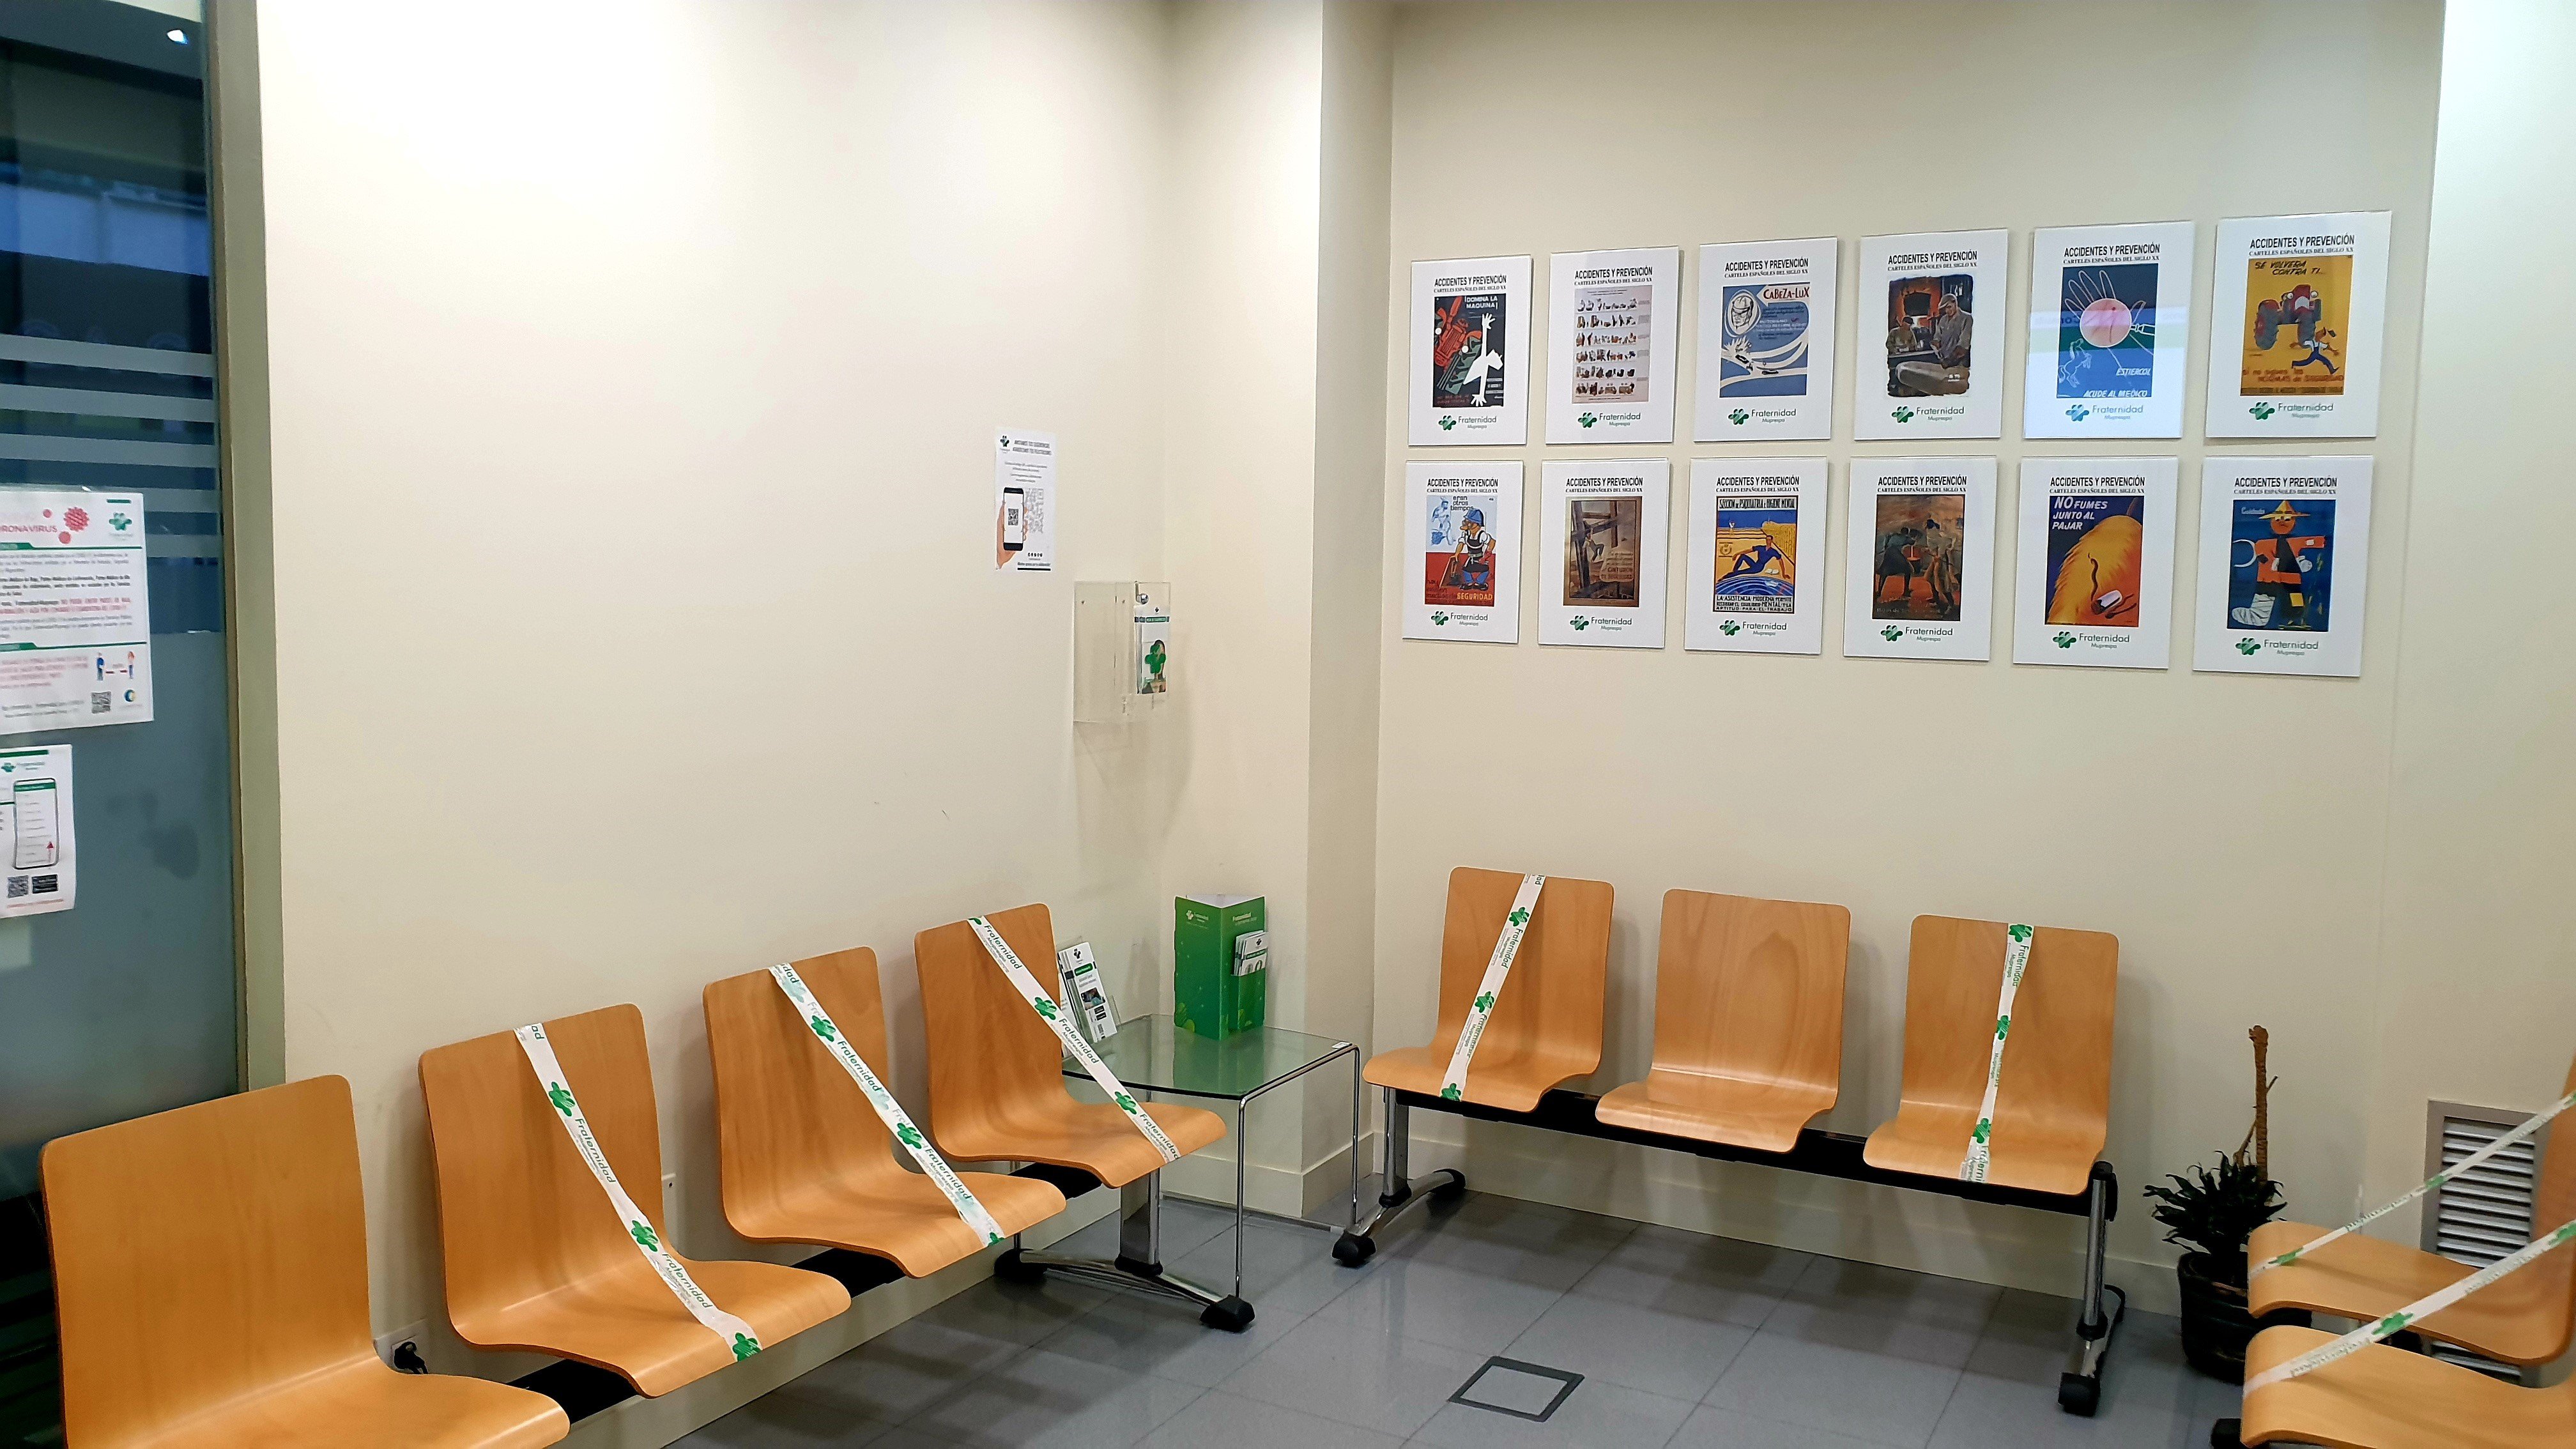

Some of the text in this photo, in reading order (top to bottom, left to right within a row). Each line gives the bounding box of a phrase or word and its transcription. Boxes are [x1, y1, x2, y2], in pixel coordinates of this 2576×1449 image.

[2250, 232, 2354, 249] ACCIDENTES Y PREVENCIÓN
[2064, 242, 2160, 257] ACCIDENTES Y PREVENCIÓN
[1888, 249, 1977, 264] ACCIDENTES Y PREVENCIÓN
[1725, 257, 1808, 272] ACCIDENTES Y PREVENCIÓN
[1575, 269, 1610, 279] ACCIDENTES
[1616, 266, 1653, 277] PREVENCIÓN
[1434, 274, 1506, 287] ACCIDENTES Y PREVENCIÓN
[1751, 408, 1796, 417] Fraternidad
[1917, 406, 1964, 415] Fraternidad
[2278, 402, 2333, 411] Fraternidad
[1427, 479, 1459, 487] ACCIDENTES
[1465, 477, 1498, 487] PREVENCIÓN
[1566, 478, 1600, 486] ACCIDENTES
[1607, 476, 1643, 486] PREVENCIÓN
[1717, 474, 1799, 486] ACCIDENTES Y PREVENCIÓN
[1878, 474, 1966, 486] ACCIDENTES Y PREVENCIÓN
[2050, 474, 2145, 486] ACCIDENTES Y PREVENCIÓN
[2234, 475, 2337, 487] ACCIDENTES Y PREVENCIÓN
[2054, 496, 2108, 509] NO FUMES
[2083, 512, 2095, 520] AL
[1457, 592, 1492, 601] SEGURIDAD
[1450, 612, 1488, 620] Fraternidad
[1591, 617, 1632, 625] Fraternidad
[1743, 621, 1787, 630] Fraternidad
[1905, 626, 1953, 635] Fraternidad
[2079, 632, 2130, 642] Fraternidad
[2264, 639, 2319, 649] Fraternidad
[984, 925, 1022, 969] Fraternidad
[1501, 928, 1523, 969] Fraternidad
[1059, 1018, 1100, 1064] Fraternidad
[838, 1041, 882, 1092] Fraternidad
[575, 1119, 616, 1183] Fraternidad
[925, 1148, 972, 1199] Fraternidad
[662, 1254, 713, 1308] Fraternidad
